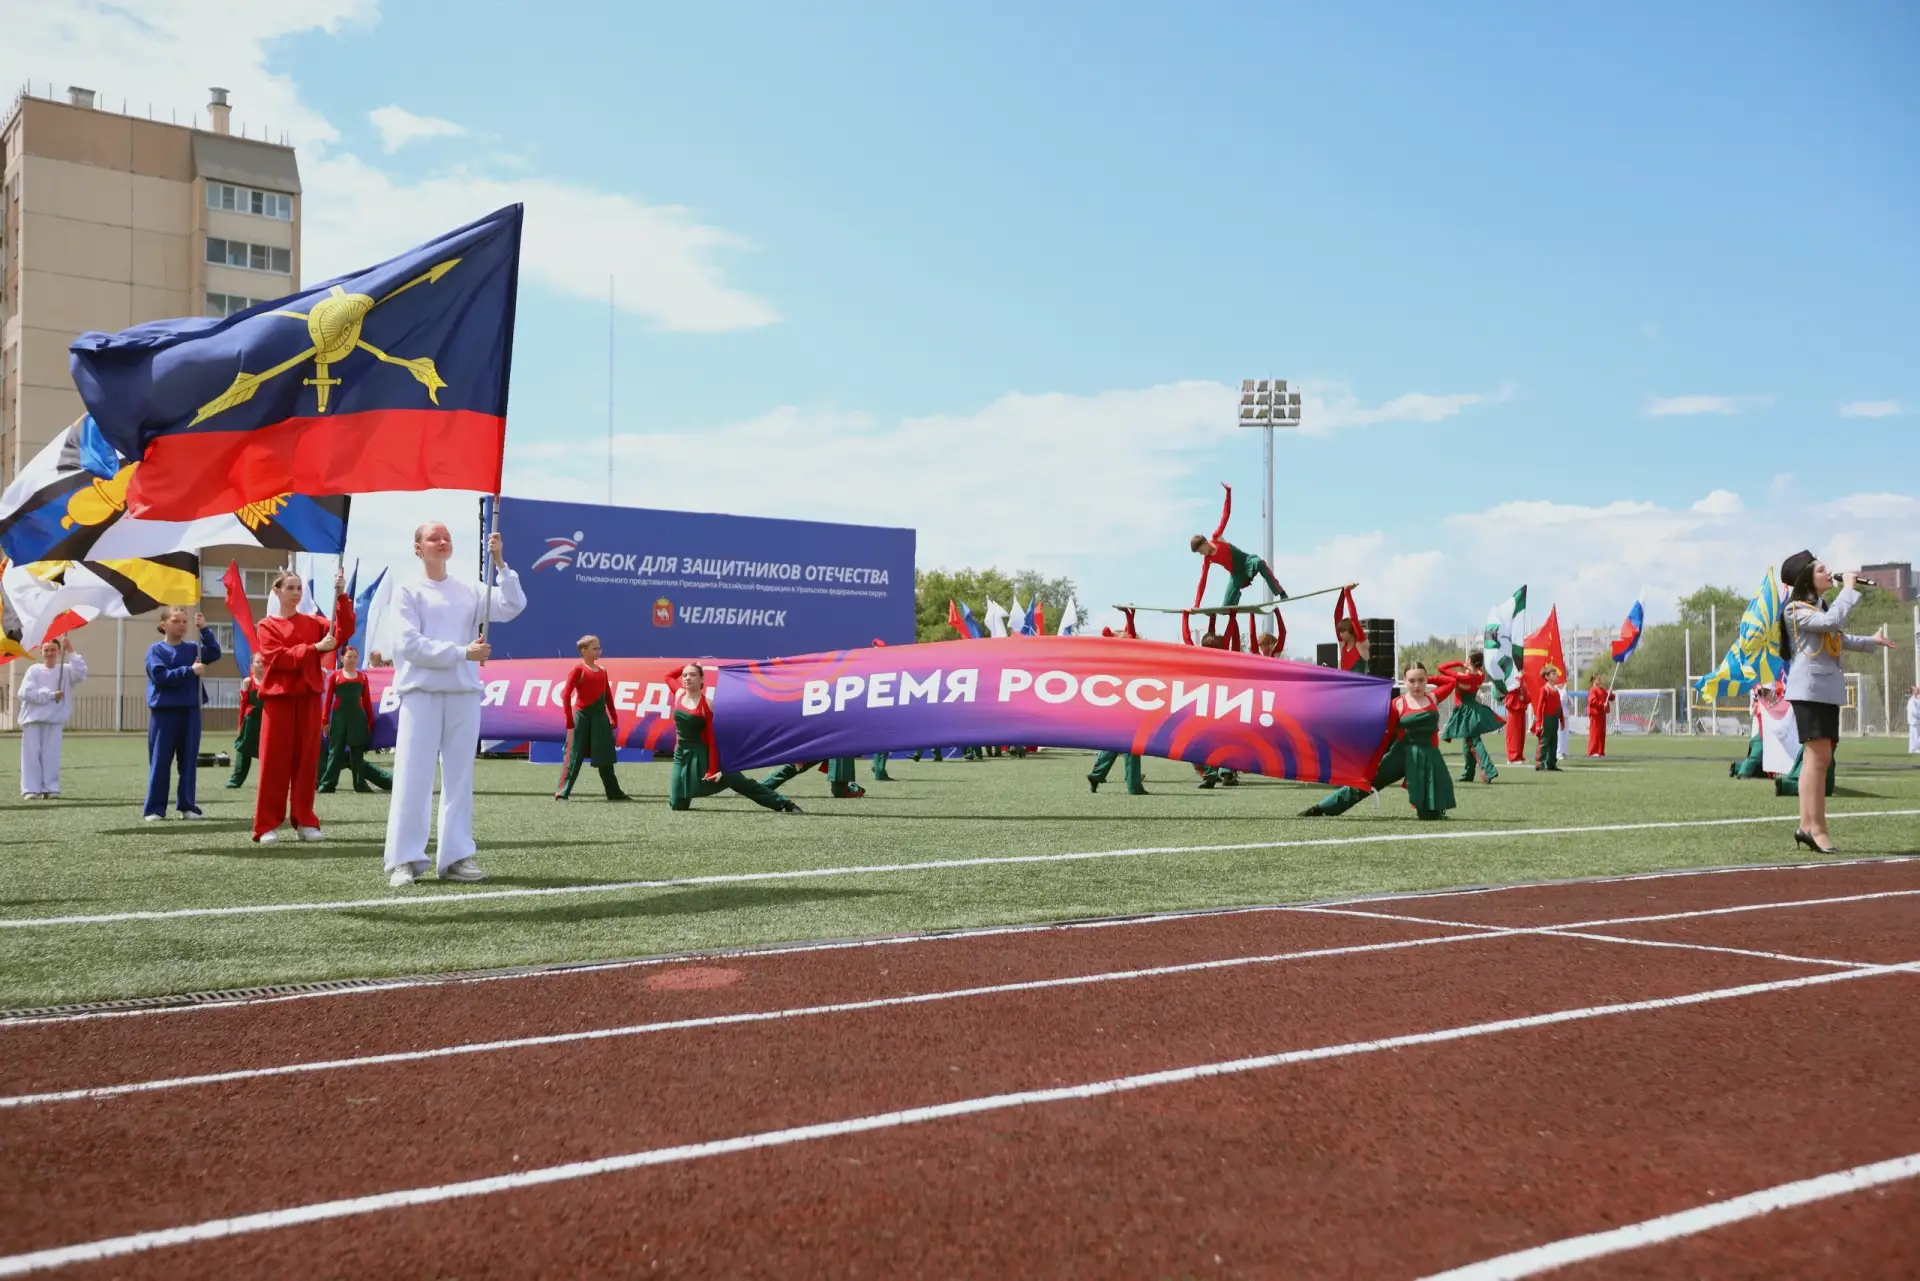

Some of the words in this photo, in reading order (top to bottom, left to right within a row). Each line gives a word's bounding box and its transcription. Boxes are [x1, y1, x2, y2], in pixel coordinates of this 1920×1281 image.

[576, 551, 637, 571] КУБОК
[638, 555, 678, 575] ДЛЯ
[681, 558, 801, 580] ЗАЩИТНИКОВ
[805, 565, 889, 585] ОТЕЧЕСТВА
[576, 574, 628, 584] Полномочного
[629, 578, 679, 587] представителя
[679, 580, 717, 589] Президента
[718, 581, 755, 591] Российской
[679, 606, 787, 627] ЧЕЛЯБИНСК
[802, 669, 978, 716] ВРЕМЯ
[998, 669, 1276, 727] РОССИИ!
